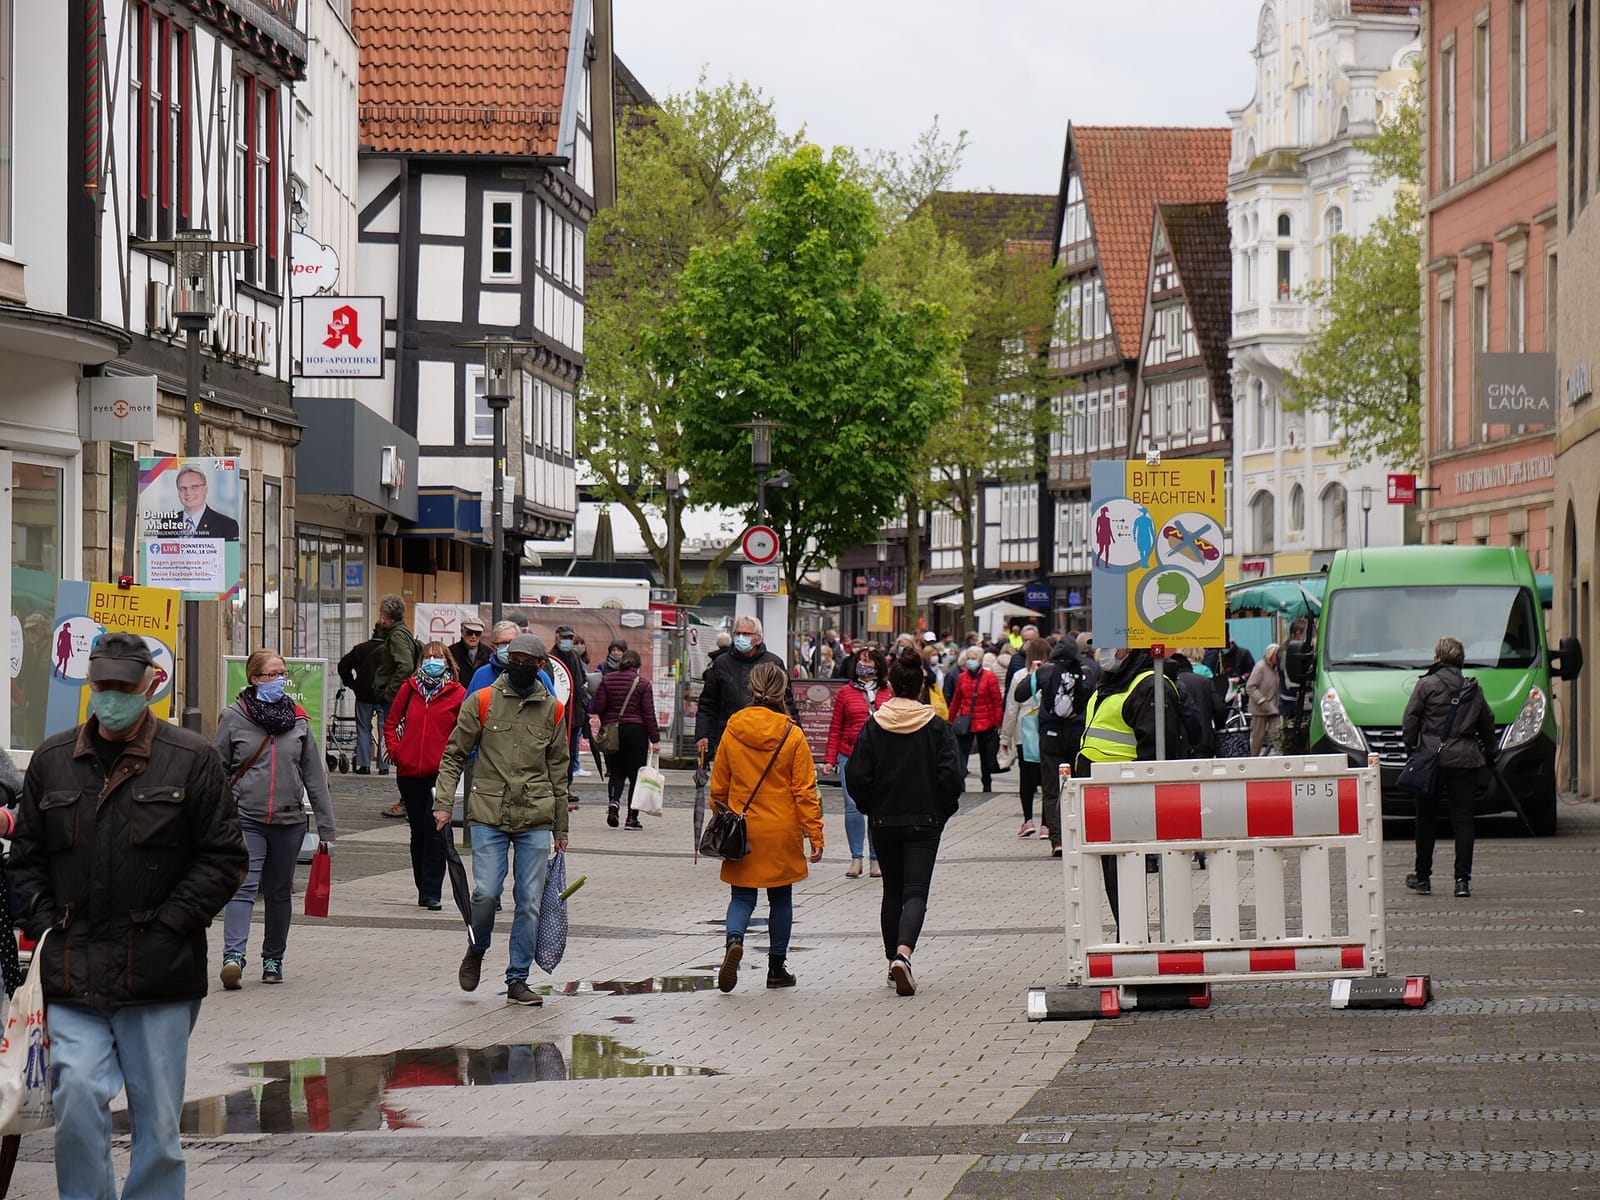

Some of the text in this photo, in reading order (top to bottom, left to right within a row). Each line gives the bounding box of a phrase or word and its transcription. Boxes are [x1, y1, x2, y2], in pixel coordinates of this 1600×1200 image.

[152, 280, 271, 366] HOPOTHEKE
[306, 356, 379, 365] HOF-APOTHEKE
[1488, 384, 1527, 397] GINA
[93, 404, 113, 414] eyes
[129, 404, 153, 412] more
[1488, 396, 1550, 410] LAURA
[1132, 470, 1181, 487] BITTE
[1132, 490, 1206, 504] BEACHTEN
[143, 509, 179, 519] Dennis
[95, 592, 140, 611] BITTE
[1027, 591, 1049, 600] CECIL
[93, 611, 161, 629] BEACHTEN
[1294, 783, 1334, 797] FB 5
